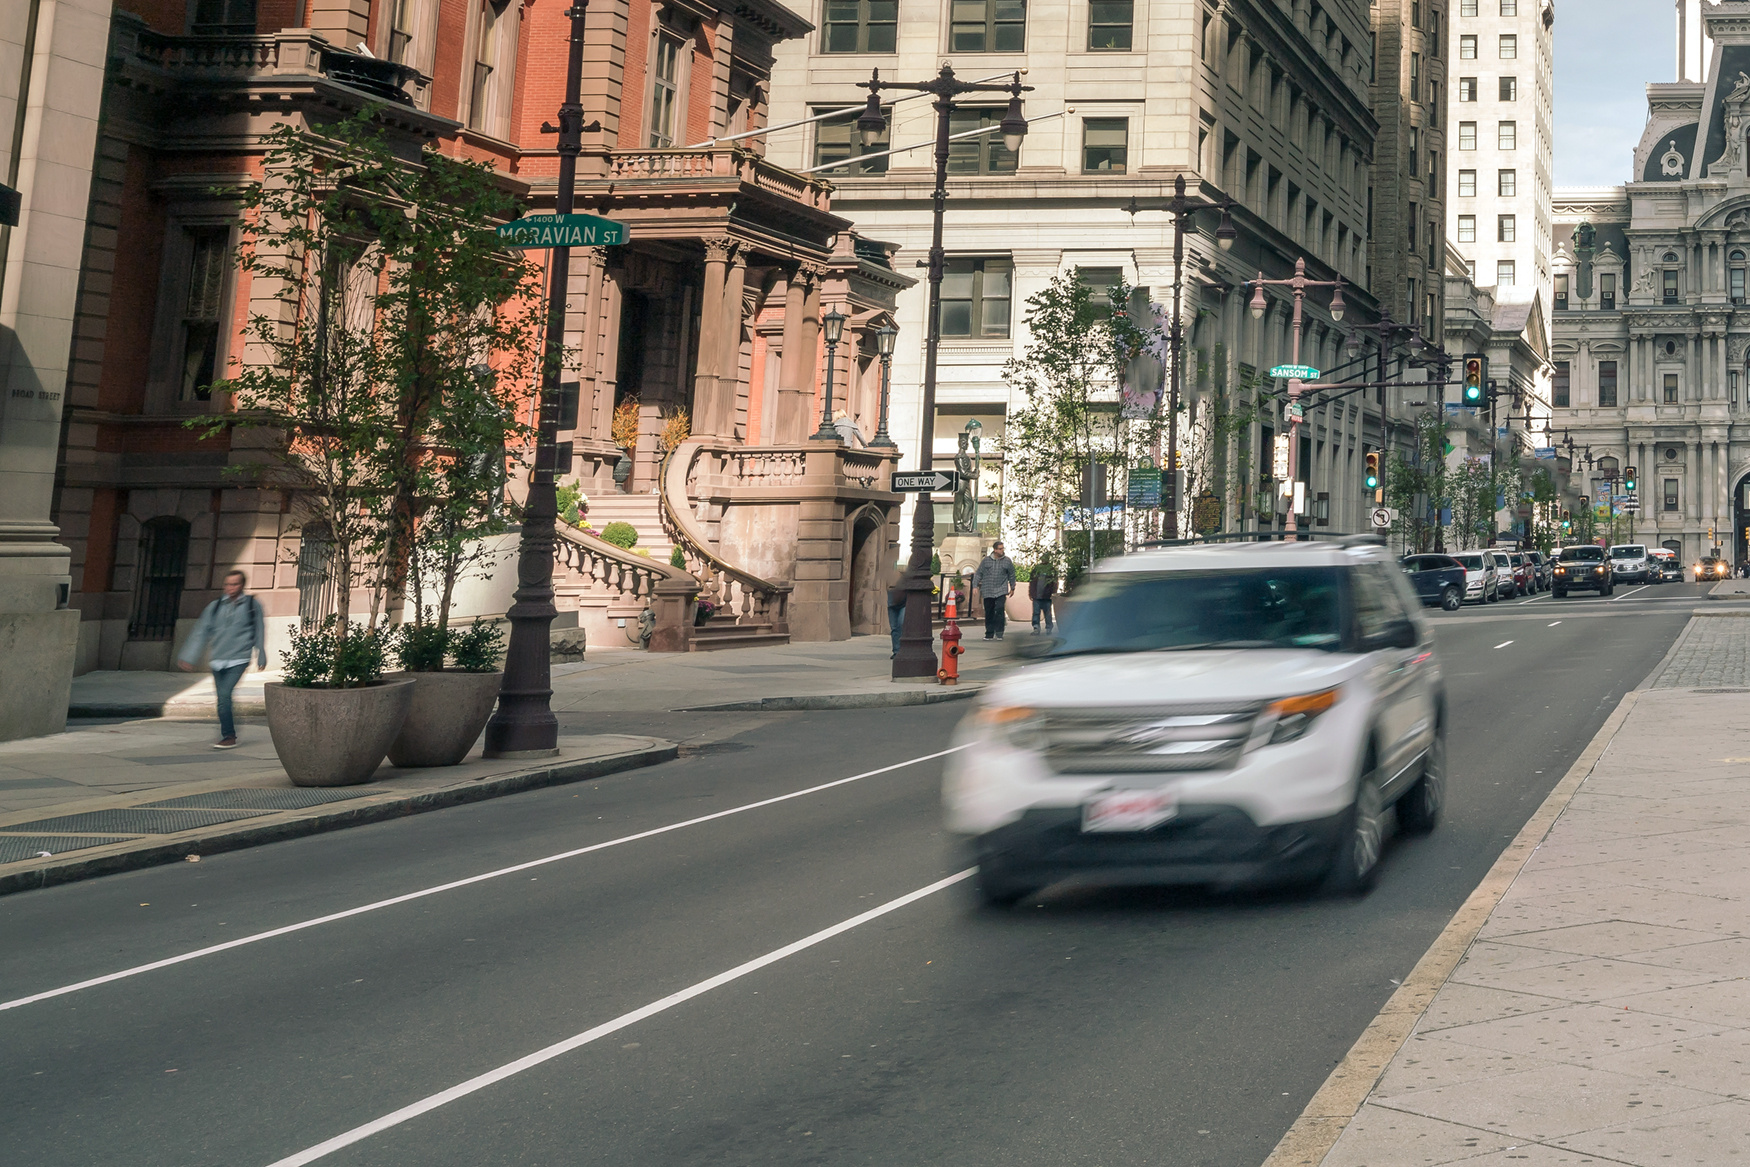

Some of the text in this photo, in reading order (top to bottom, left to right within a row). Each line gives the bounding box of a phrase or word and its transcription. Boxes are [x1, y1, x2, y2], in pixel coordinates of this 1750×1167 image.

[555, 215, 565, 224] W
[500, 226, 618, 244] MORAVIAN ST
[1271, 368, 1308, 378] SANSOM
[11, 389, 61, 401] BROAD STREET
[897, 477, 936, 486] ONE WAY
